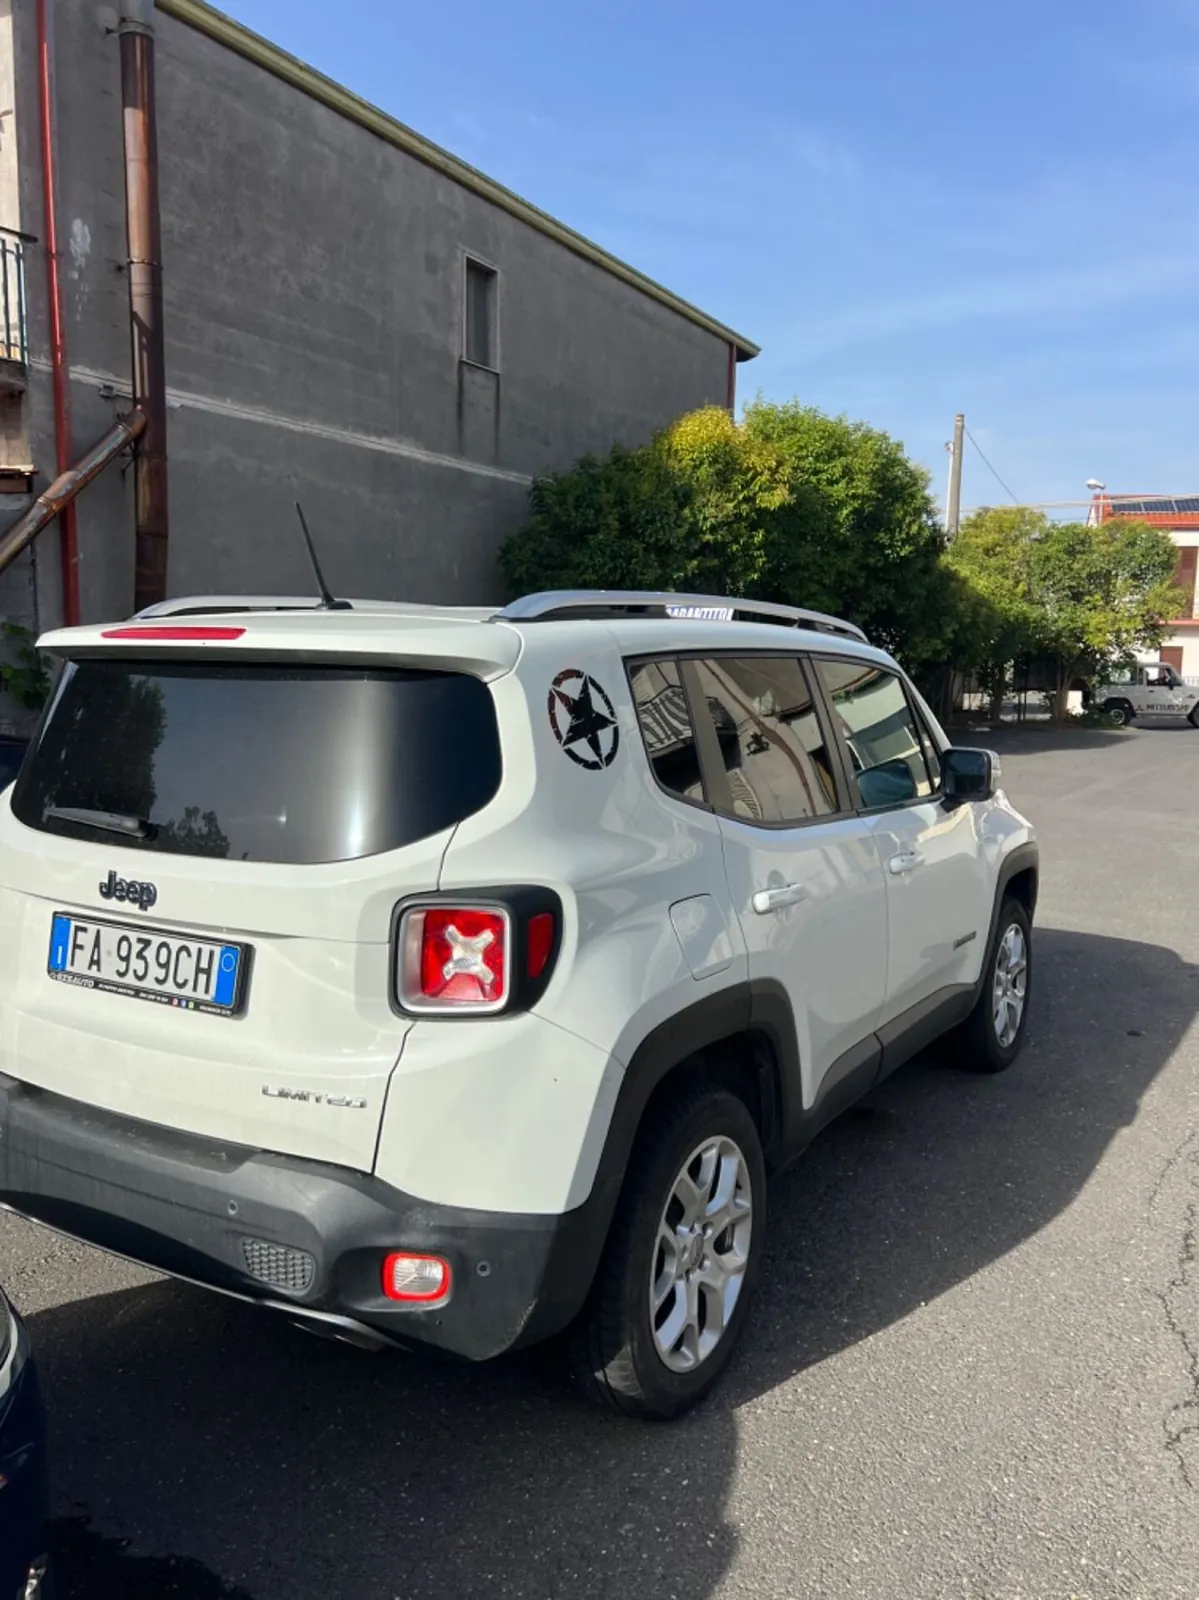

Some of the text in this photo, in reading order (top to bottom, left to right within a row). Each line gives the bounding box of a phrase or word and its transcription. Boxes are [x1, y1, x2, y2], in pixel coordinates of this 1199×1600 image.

[98, 869, 158, 912] Jeep
[69, 924, 102, 973] FA
[115, 934, 216, 995] 939CH
[261, 1084, 368, 1109] LIMITED
